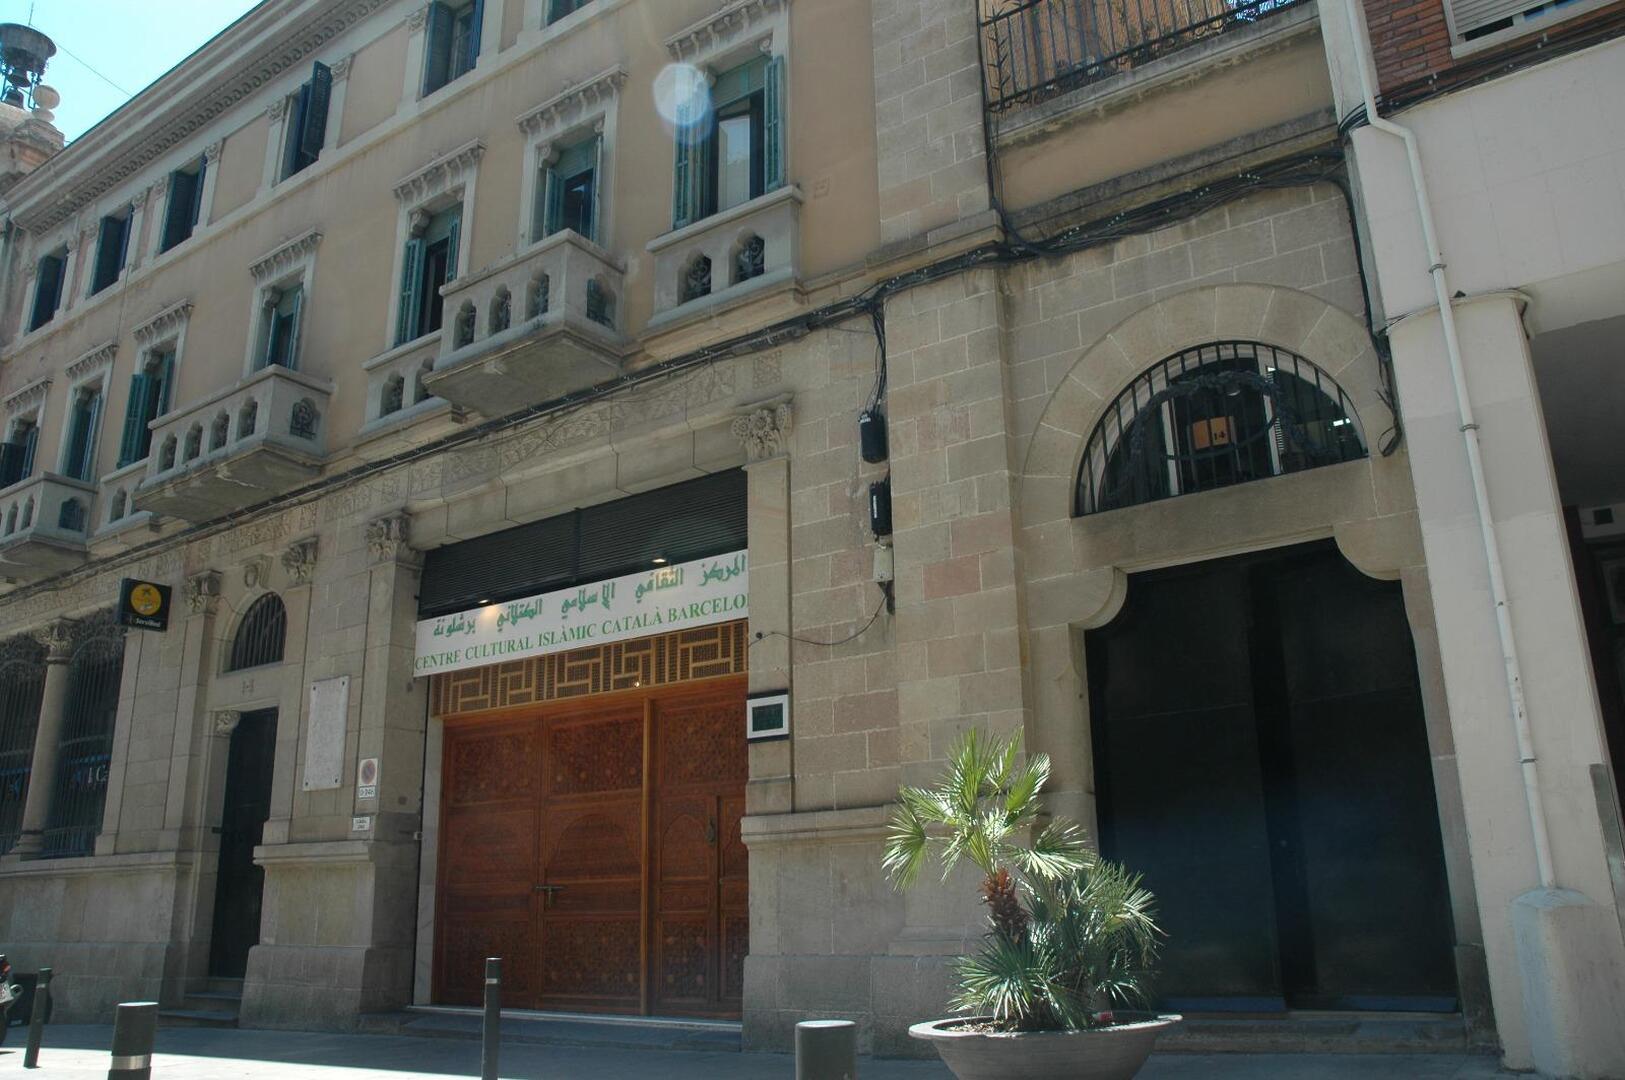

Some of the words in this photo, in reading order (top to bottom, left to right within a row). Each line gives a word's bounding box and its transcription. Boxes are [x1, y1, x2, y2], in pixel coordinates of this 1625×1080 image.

[698, 554, 747, 587] المركز
[415, 649, 461, 671] CENTRE
[465, 636, 534, 661] CULTURAL
[538, 623, 597, 647] ISLÀMIC
[602, 606, 663, 635] CATALÀ
[668, 593, 749, 623] BARCELO
[433, 613, 476, 638] برشلونة
